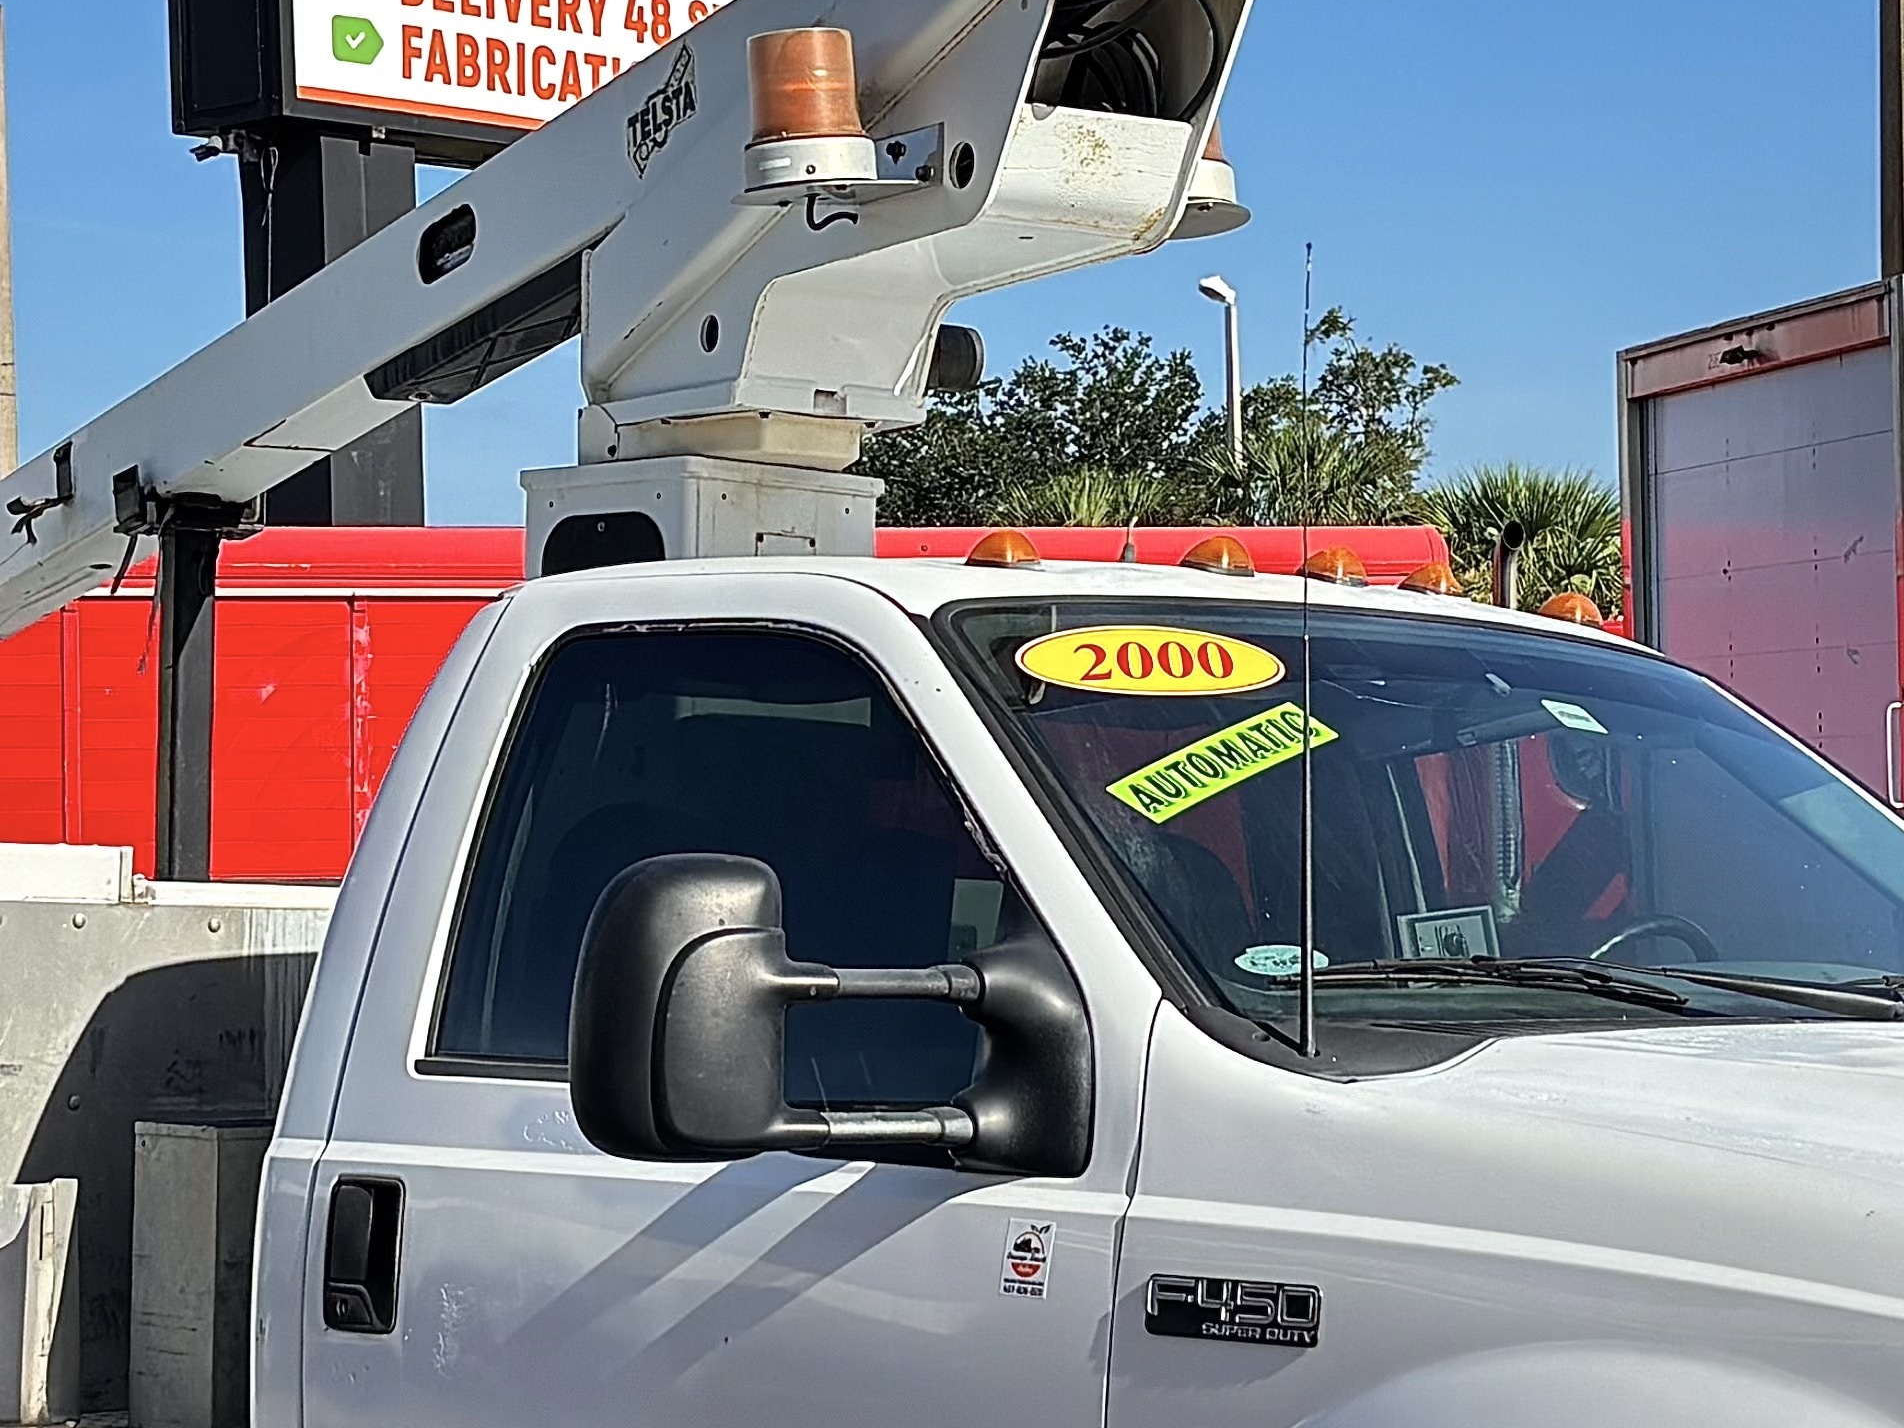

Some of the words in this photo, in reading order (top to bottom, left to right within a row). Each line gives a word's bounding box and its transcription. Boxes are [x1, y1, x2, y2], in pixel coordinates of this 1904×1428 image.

[402, 24, 636, 103] FABRICAT
[1072, 641, 1235, 683] 2000
[1128, 710, 1322, 815] AUTOMATIC
[1201, 1322, 1262, 1340] SUPER
[1265, 1327, 1316, 1344] DUTY
